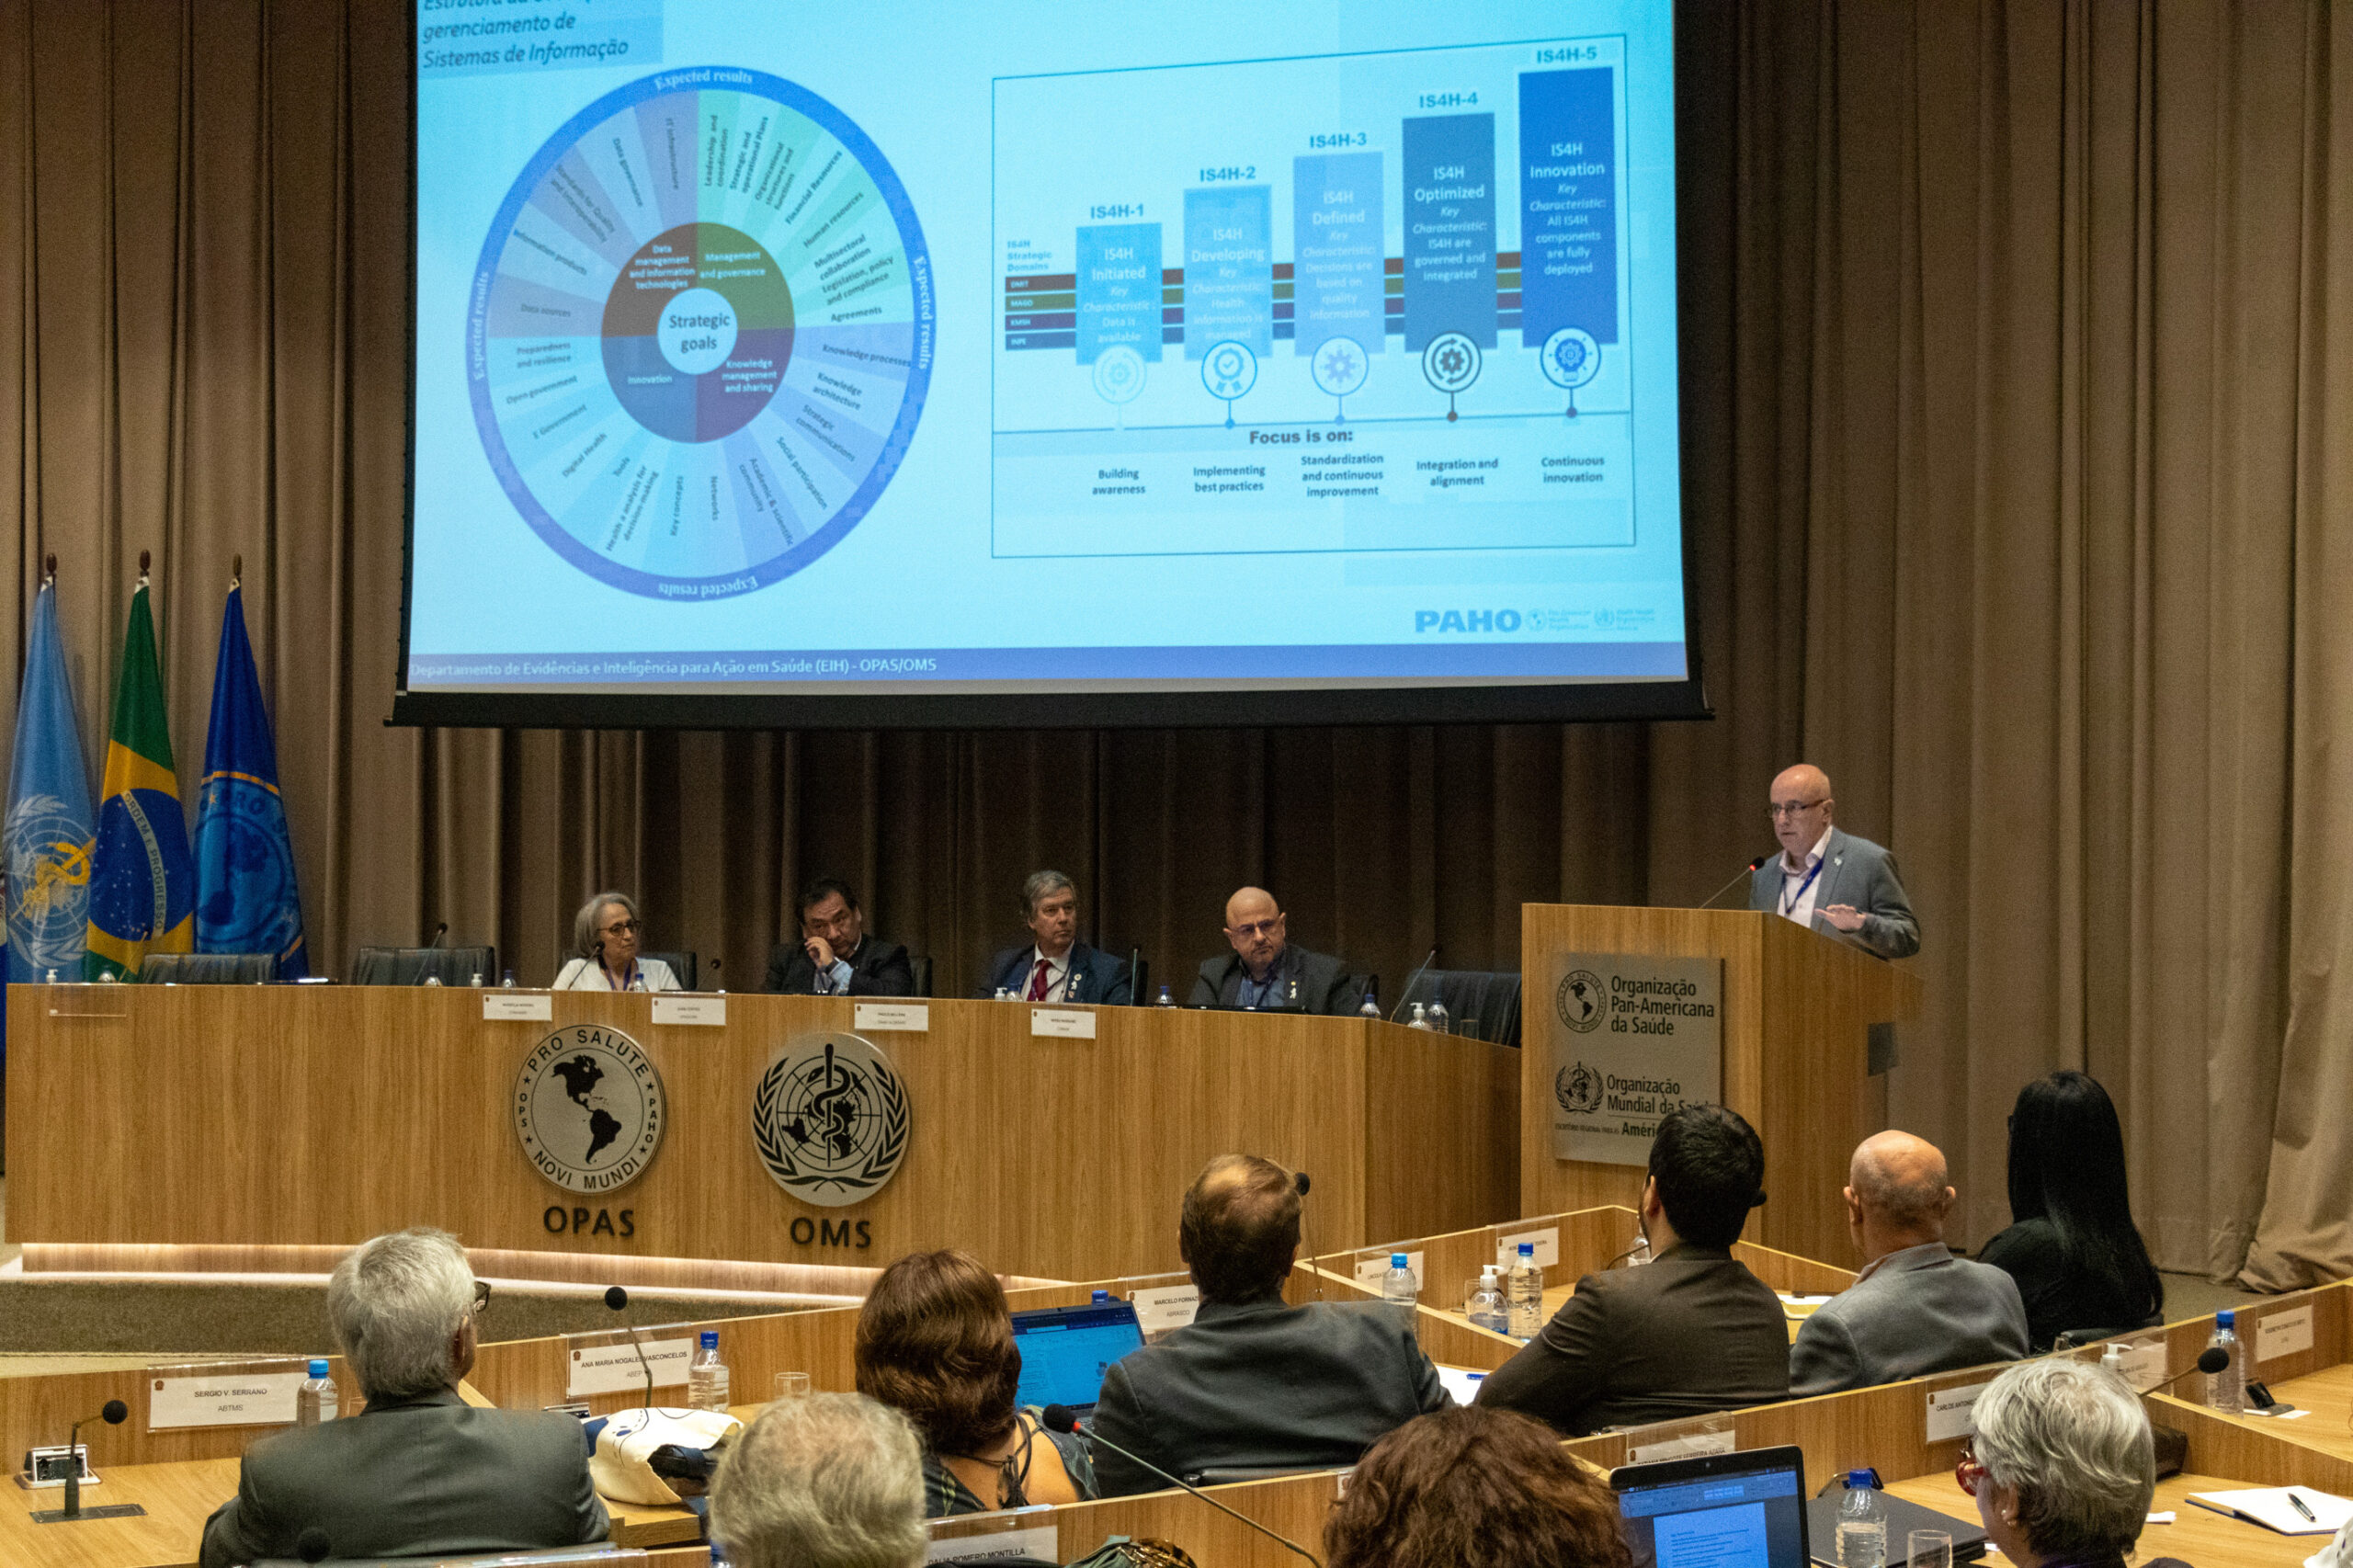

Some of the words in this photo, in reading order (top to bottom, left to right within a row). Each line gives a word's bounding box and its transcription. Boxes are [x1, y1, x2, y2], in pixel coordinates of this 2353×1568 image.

[423, 16, 550, 44] gerenciamento
[554, 11, 575, 30] de
[423, 47, 500, 69] Sistemas
[505, 45, 525, 63] de
[529, 40, 629, 65] Informação
[1537, 46, 1597, 63] IS4H-5
[654, 69, 710, 91] Expected
[711, 68, 753, 86] results
[1419, 92, 1478, 108] IS4H-4
[1310, 132, 1367, 148] IS4H-3
[1551, 142, 1583, 157] IS4H
[1199, 165, 1256, 182] IS4H-2
[1434, 166, 1464, 180] IS4H
[1530, 163, 1605, 179] Innovation
[785, 187, 813, 225] Financial
[811, 150, 843, 191] Resources
[1414, 185, 1484, 204] Optimized
[1558, 184, 1577, 196] Key
[1324, 190, 1354, 204] IS4H
[830, 192, 864, 226] resources
[1090, 204, 1143, 219] IS4H-1
[1440, 206, 1460, 218] Key
[1313, 210, 1365, 225] Defined
[1547, 216, 1563, 227] All
[1564, 215, 1588, 226] IS4H
[1213, 228, 1243, 241] IS4H
[1536, 232, 1601, 246] components
[813, 233, 867, 269] Multisectoral
[1428, 238, 1451, 249] IS4H
[1454, 239, 1472, 248] are
[704, 251, 761, 266] Management
[1104, 248, 1132, 261] IS4H
[1192, 248, 1265, 263] Developing
[1415, 254, 1462, 268] governed
[1466, 252, 1485, 264] and
[1547, 249, 1564, 259] are
[1567, 246, 1590, 261] fully
[819, 247, 871, 281] collaboration
[868, 256, 895, 274] policy
[1544, 262, 1593, 277] deployed
[699, 270, 716, 280] and
[1091, 266, 1146, 281] Initiated
[476, 270, 490, 316] results
[844, 272, 890, 301] compliance
[912, 255, 934, 321] Expected
[1110, 287, 1128, 298] Key
[669, 312, 730, 333] Strategic
[830, 306, 882, 324] Agreements
[472, 317, 488, 381] Expected
[681, 335, 718, 356] goals
[917, 324, 936, 370] results
[725, 358, 774, 370] Knowledge
[823, 344, 869, 361] Knowledge
[869, 352, 912, 369] processes
[627, 374, 673, 386] Innovation
[722, 370, 778, 382] management
[817, 372, 862, 396] Knowledge
[724, 382, 742, 393] and
[742, 382, 774, 394] sharing
[813, 385, 861, 411] architecture
[802, 404, 835, 431] Strategic
[1249, 430, 1301, 445] Focus
[1306, 429, 1322, 442] is
[1326, 429, 1353, 442] on:
[1301, 453, 1384, 467] Standardization
[1416, 459, 1476, 472] Integration
[1478, 458, 1499, 470] and
[1540, 456, 1605, 468] Continuous
[777, 436, 796, 467] Social
[791, 456, 827, 510] participation
[1098, 469, 1140, 481] Building
[1193, 465, 1266, 479] Implementing
[1302, 470, 1322, 481] and
[1324, 469, 1383, 482] continuous
[1543, 472, 1604, 483] innovation
[1194, 481, 1217, 493] best
[1219, 480, 1265, 494] practices
[1430, 474, 1485, 488] alignment
[710, 475, 719, 521] Networks
[1092, 484, 1146, 496] awareness
[1306, 485, 1379, 498] improvement
[658, 582, 699, 597] results
[699, 575, 758, 597] Expected
[1415, 608, 1521, 633] PAHO
[412, 663, 501, 678] Departamento
[505, 663, 520, 676] de
[523, 659, 590, 676] Evidências
[593, 665, 601, 675] e
[604, 658, 677, 677] Inteligência
[679, 662, 710, 676] para
[711, 658, 744, 676] Ação
[747, 663, 768, 675] em
[771, 657, 812, 675] Saúde
[815, 657, 849, 676] (EIH)
[859, 657, 938, 675] OPAS/OMS
[123, 792, 151, 835] ORDEM
[150, 849, 165, 930] PROGRESSO
[1611, 976, 1697, 1000] Organização
[1611, 995, 1714, 1017] Pan-Americana
[1611, 1015, 1627, 1033] da
[1632, 1017, 1674, 1035] Saúde
[528, 1037, 563, 1073] PRO
[577, 1029, 649, 1078] SALUTE
[1608, 1074, 1680, 1098] Organização
[518, 1093, 529, 1128] OPS
[1608, 1096, 1654, 1114] Mundial
[1660, 1098, 1675, 1115] da
[645, 1097, 658, 1143] PAHO
[1621, 1121, 1655, 1139] Améri
[534, 1150, 573, 1186] NOVI
[584, 1157, 640, 1189] MUNDI
[543, 1206, 634, 1238] OPAS
[790, 1217, 871, 1248] OMS
[1154, 1298, 1177, 1306] MARCELO
[581, 1360, 594, 1369] ANA
[595, 1358, 614, 1367] MARIA
[644, 1351, 687, 1361] VASCONCELOS
[194, 1390, 222, 1398] SERGIO
[232, 1388, 267, 1397] SERRANO
[218, 1403, 244, 1413] ABTMS
[952, 1552, 986, 1562] ROMERO
[988, 1548, 1026, 1560] MONTILLA
